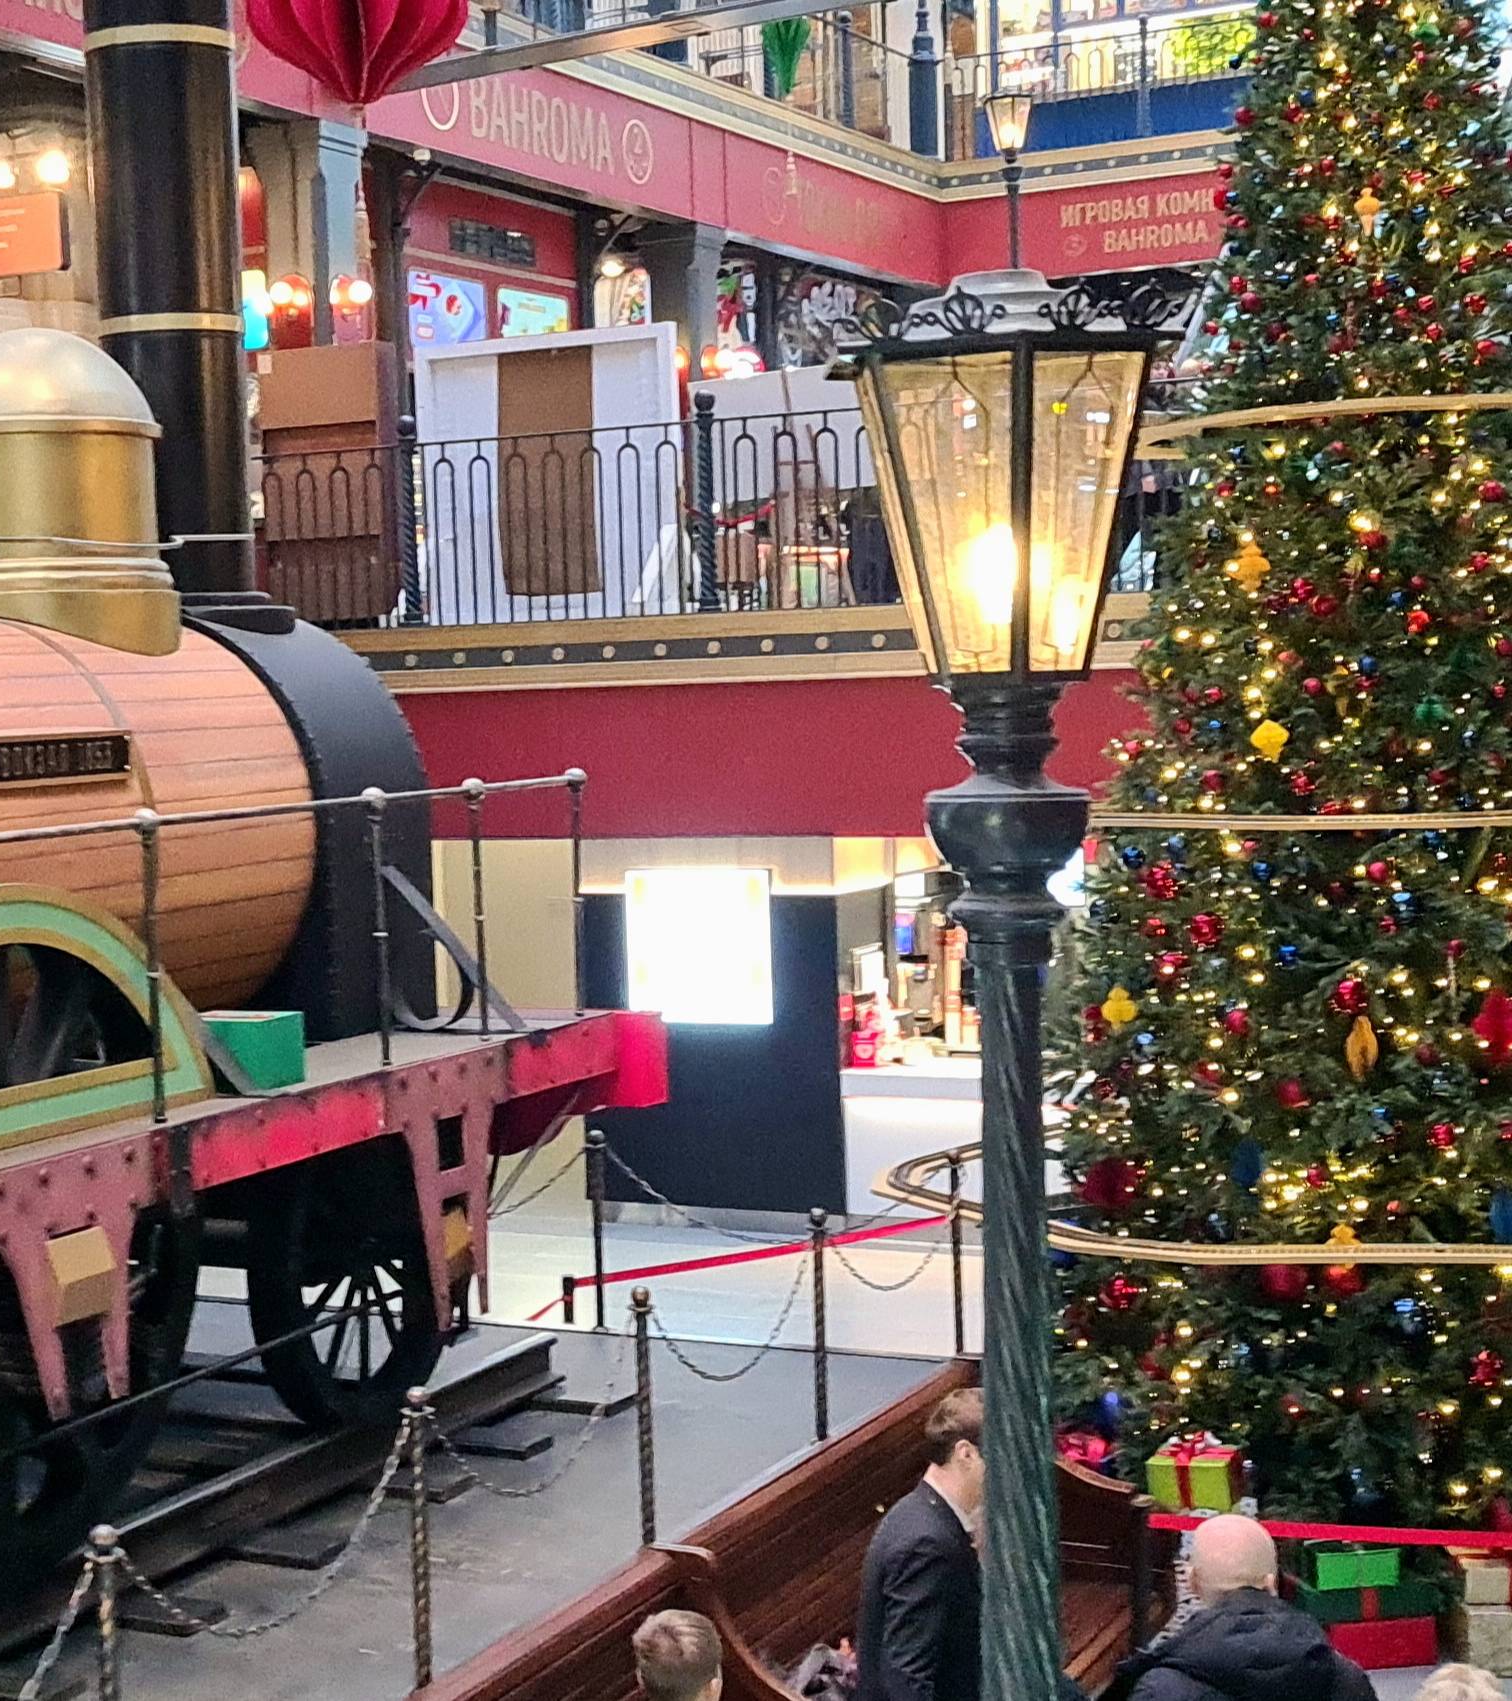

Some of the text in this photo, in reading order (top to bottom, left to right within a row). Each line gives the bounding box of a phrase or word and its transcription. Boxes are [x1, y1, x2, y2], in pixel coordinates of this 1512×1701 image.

[468, 77, 616, 176] BAHROMA
[1059, 188, 1216, 228] ИГРОВАЯ КОМН
[1103, 219, 1209, 254] BAHROMA
